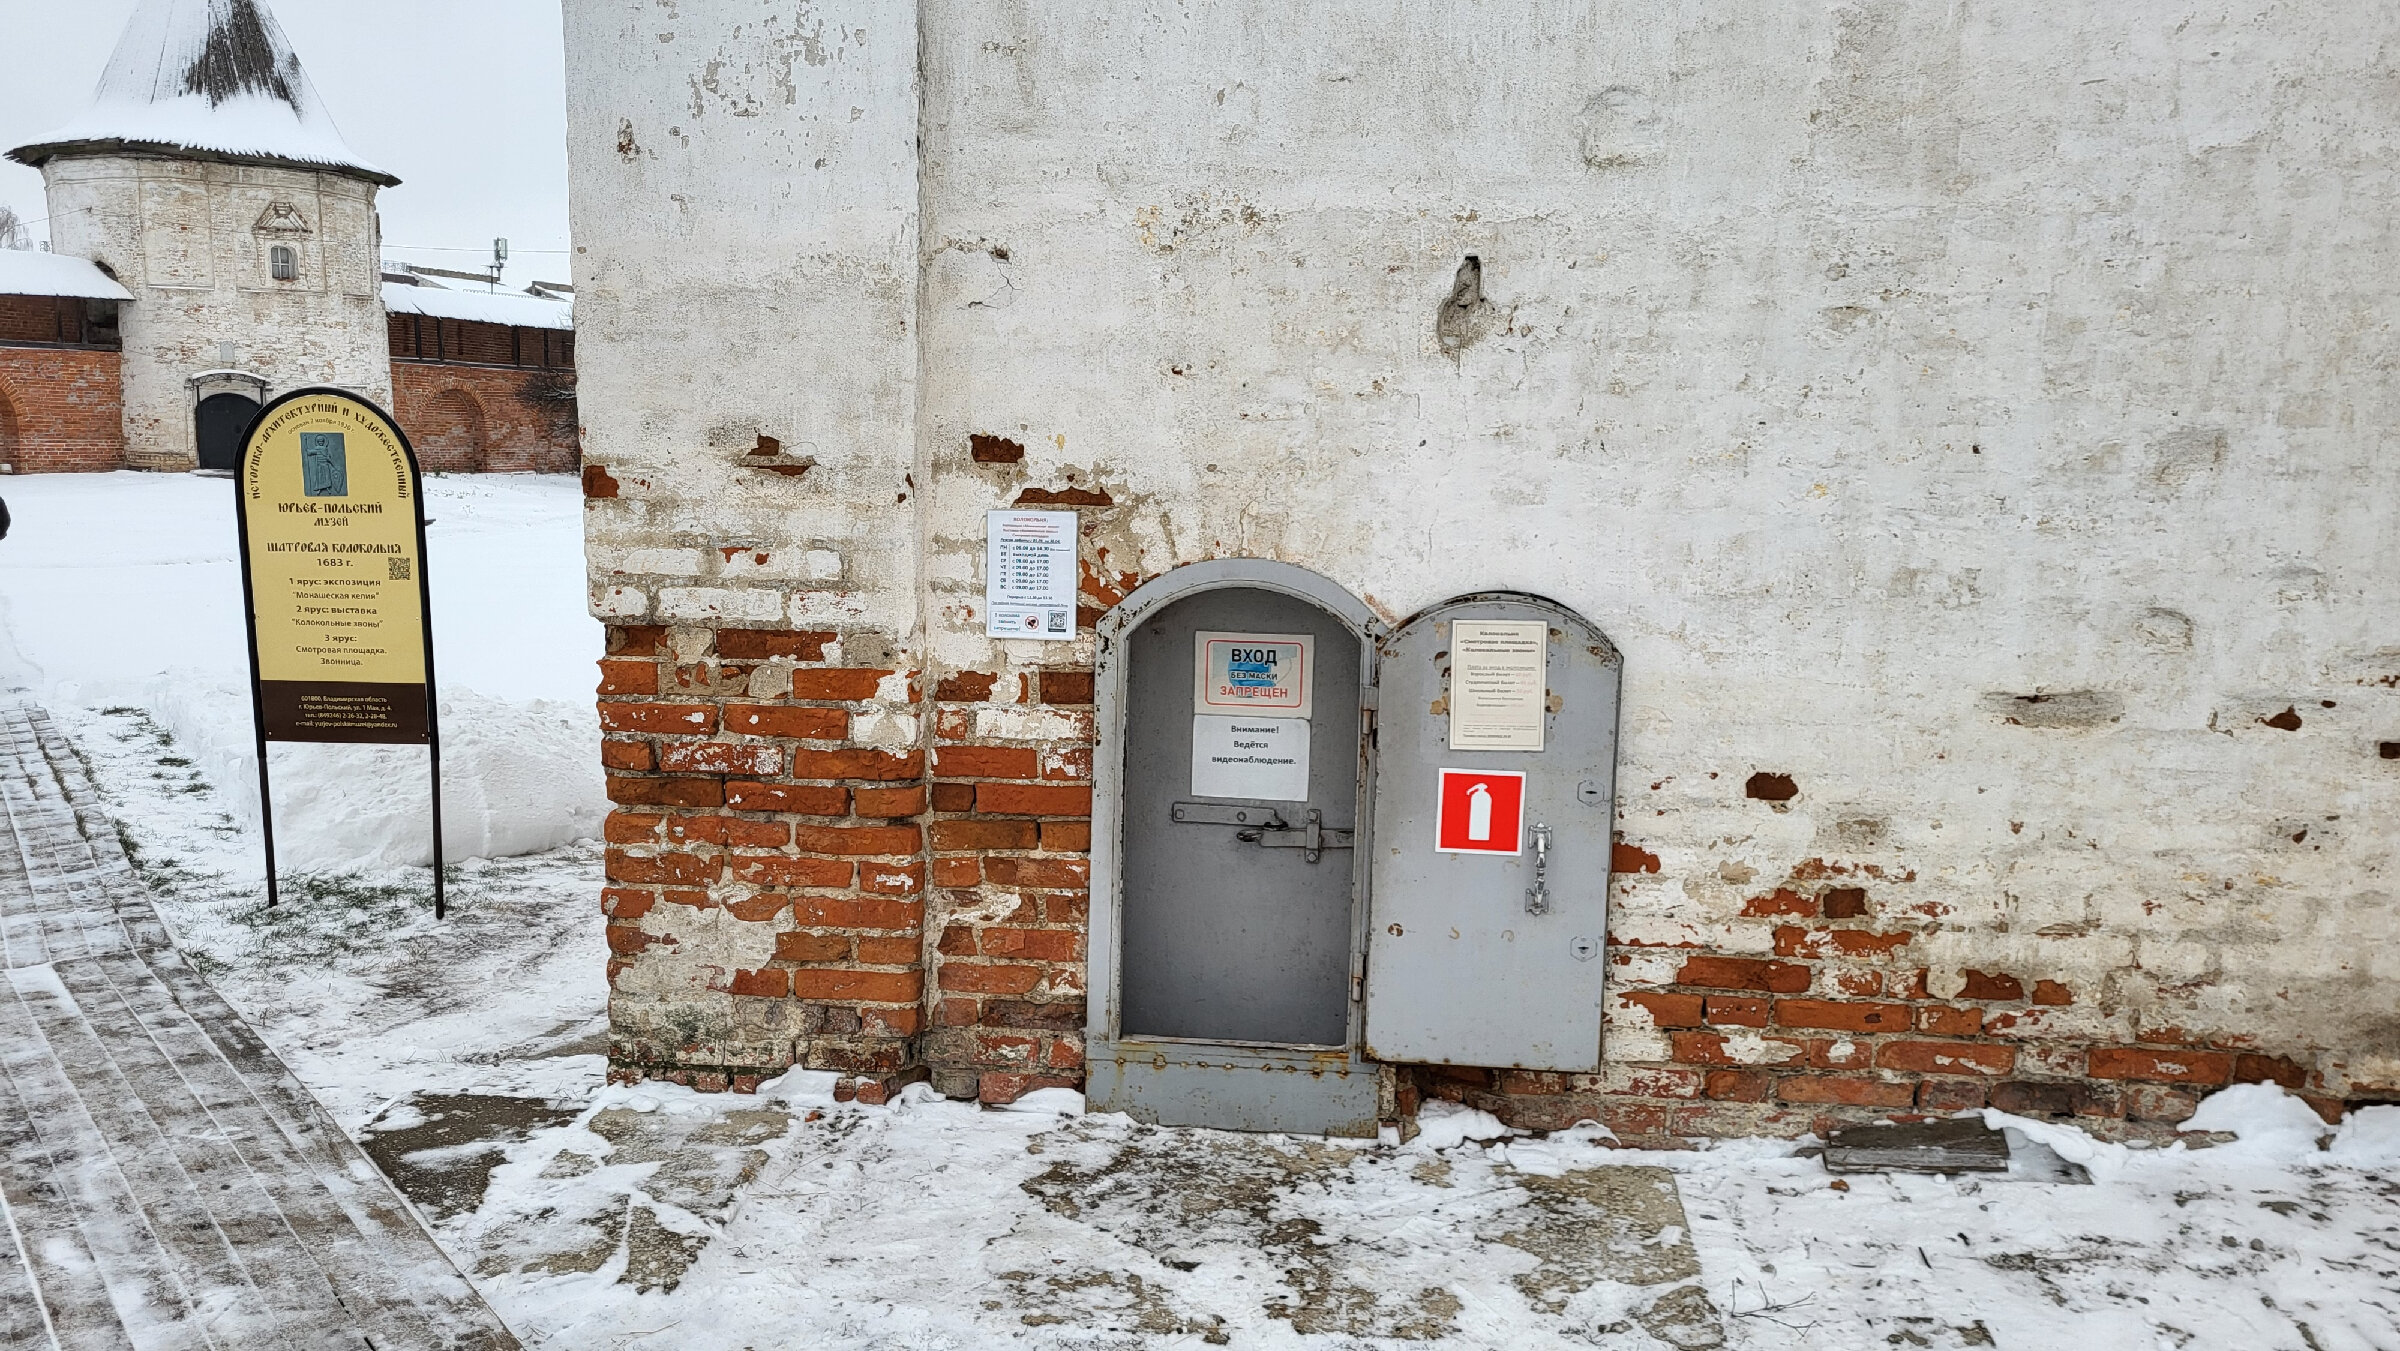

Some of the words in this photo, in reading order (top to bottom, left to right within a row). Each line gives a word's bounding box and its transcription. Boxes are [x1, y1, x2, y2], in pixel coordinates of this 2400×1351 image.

[343, 407, 349, 416] И
[278, 502, 382, 513] ЮРЬЕВ-ПОЛЬСКИЙ
[314, 517, 349, 526] МУЗЕЙ
[267, 542, 328, 553] ШАТРОВАЯ
[332, 543, 402, 554] КОЛОКОЛЬНЯ
[324, 579, 381, 587] экспозиция
[296, 646, 341, 655] Смотровая
[344, 647, 387, 655] площадка.
[320, 658, 363, 666] Звонница.
[1232, 649, 1277, 666] ВХОД
[1220, 686, 1288, 699] ЗАПРЕЩЕН
[1234, 741, 1268, 749] Ведётся
[1212, 756, 1296, 765] видеонаблюдение.
